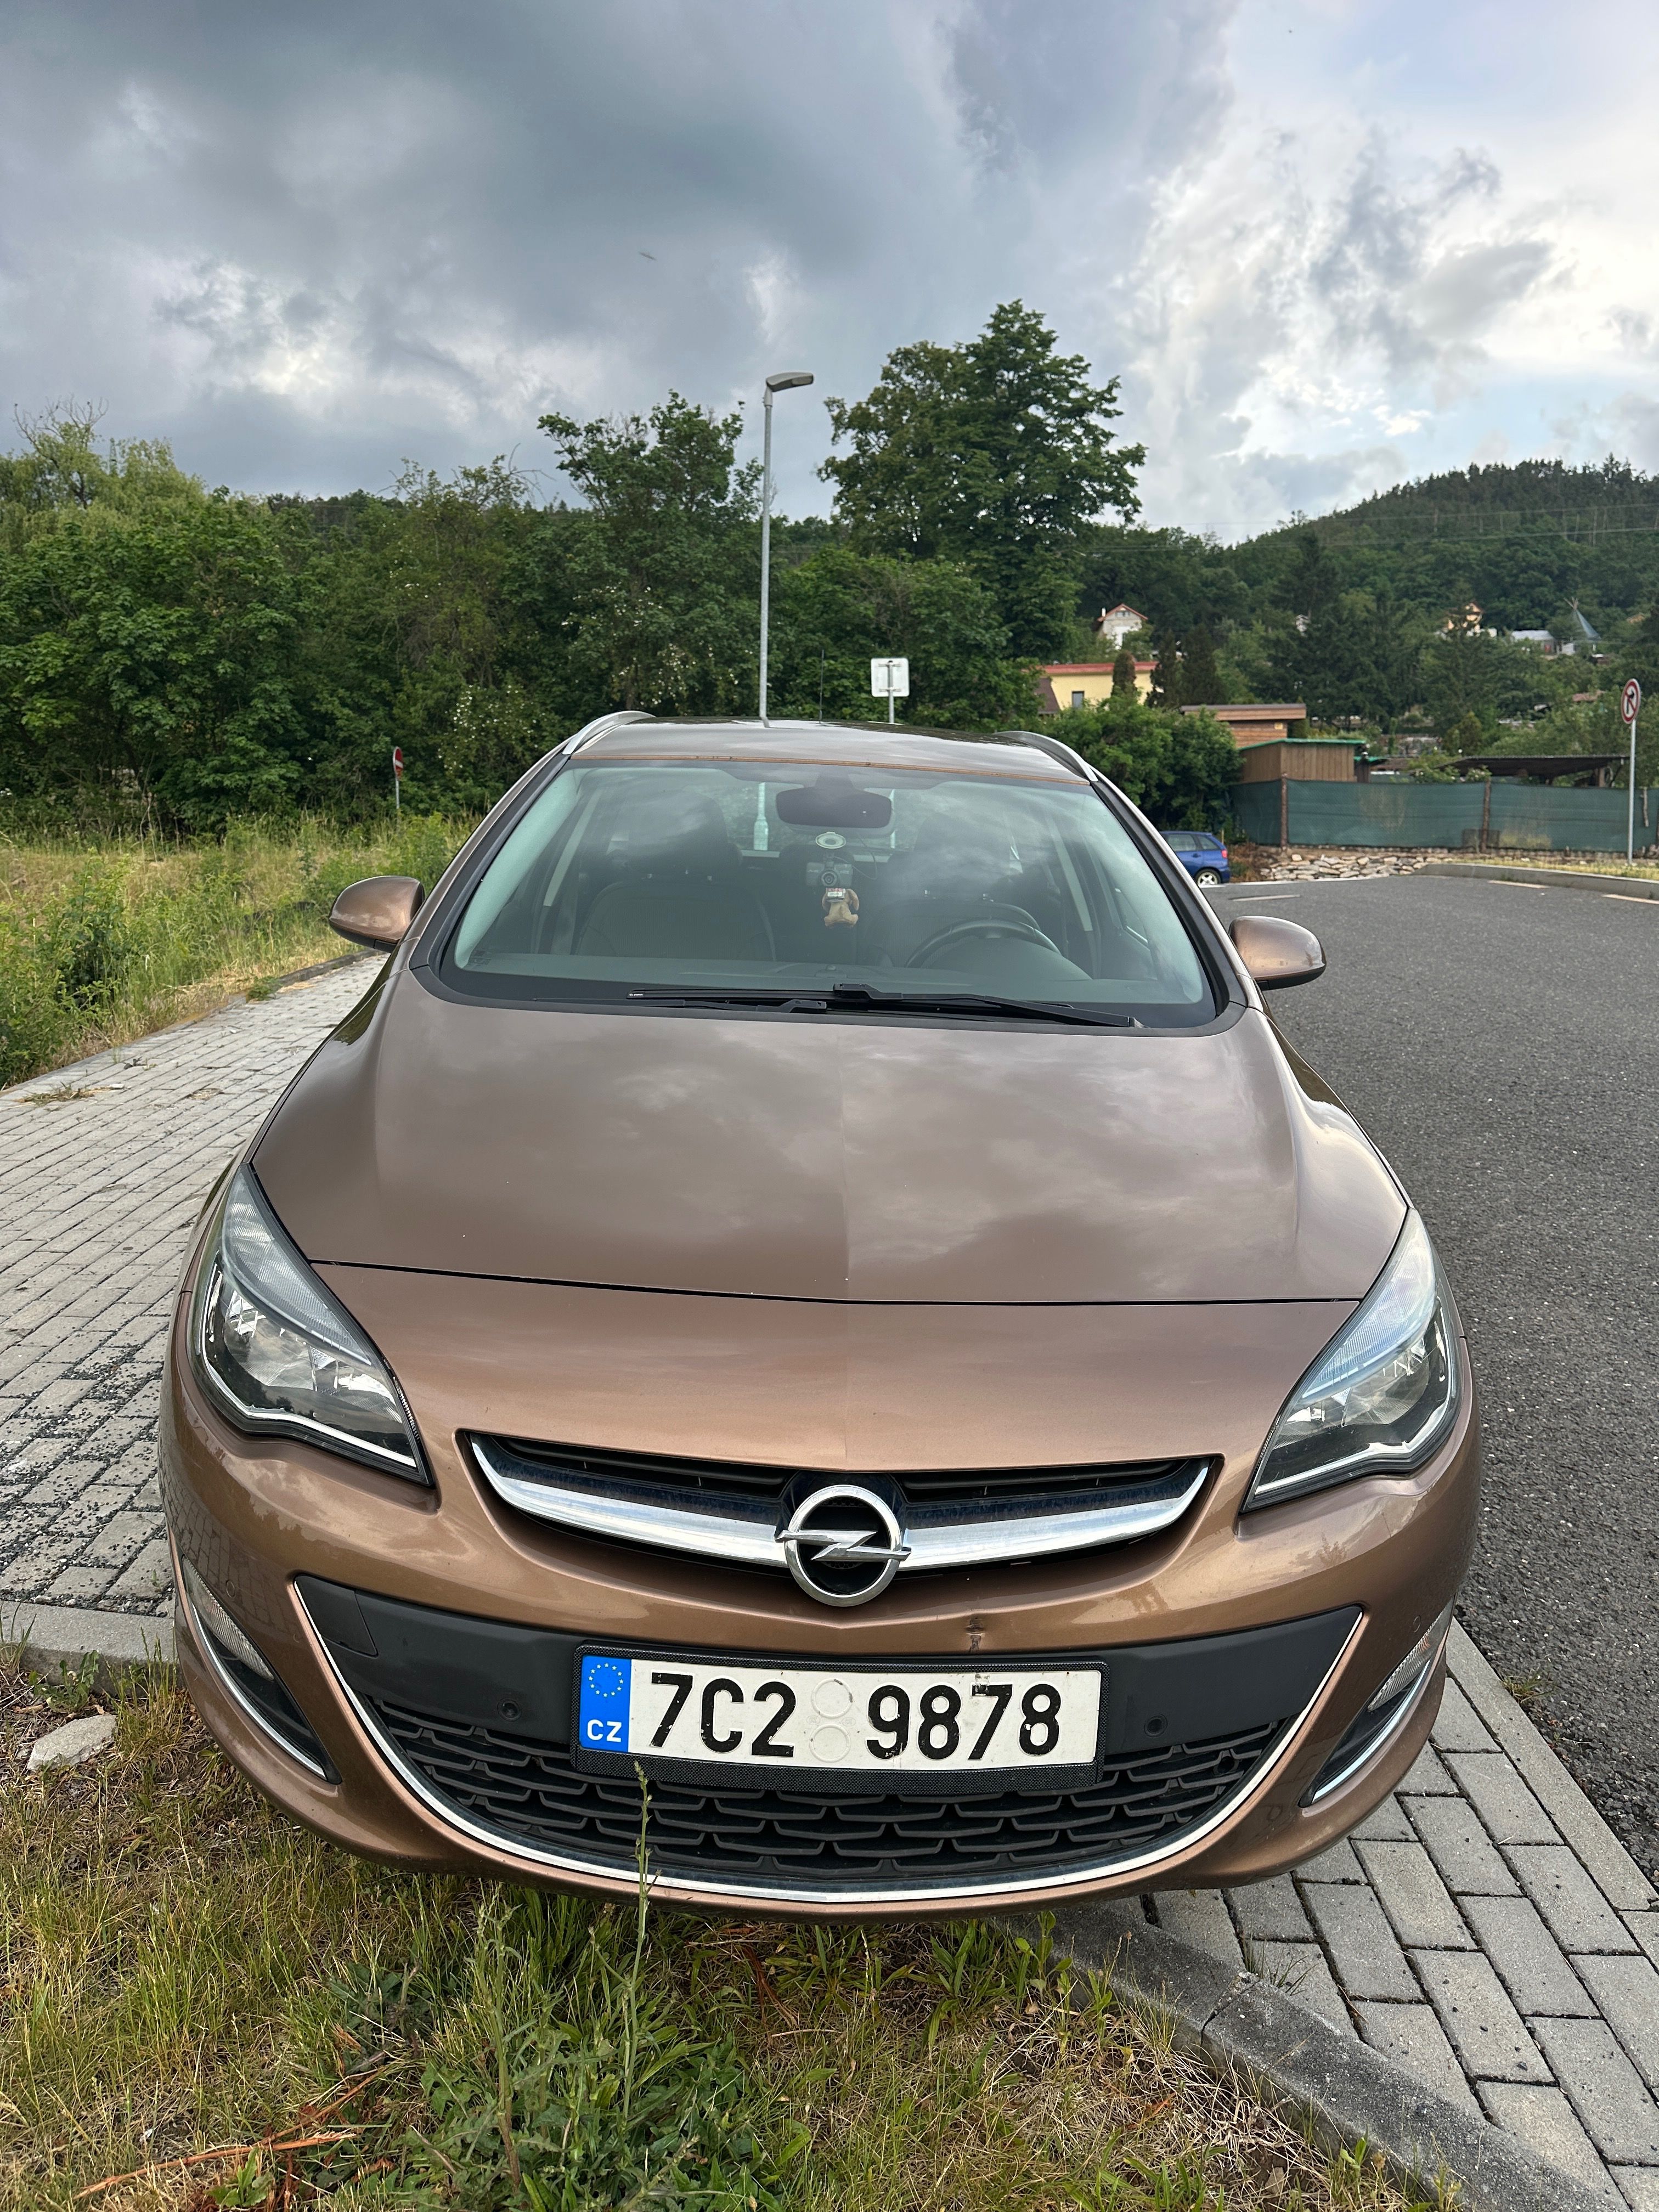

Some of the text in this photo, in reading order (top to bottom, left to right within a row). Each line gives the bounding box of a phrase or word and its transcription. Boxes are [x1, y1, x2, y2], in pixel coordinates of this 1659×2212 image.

[811, 1488, 879, 1505] OPEL
[650, 1672, 1062, 1760] 7C2 9878
[586, 1719, 622, 1743] CZ
